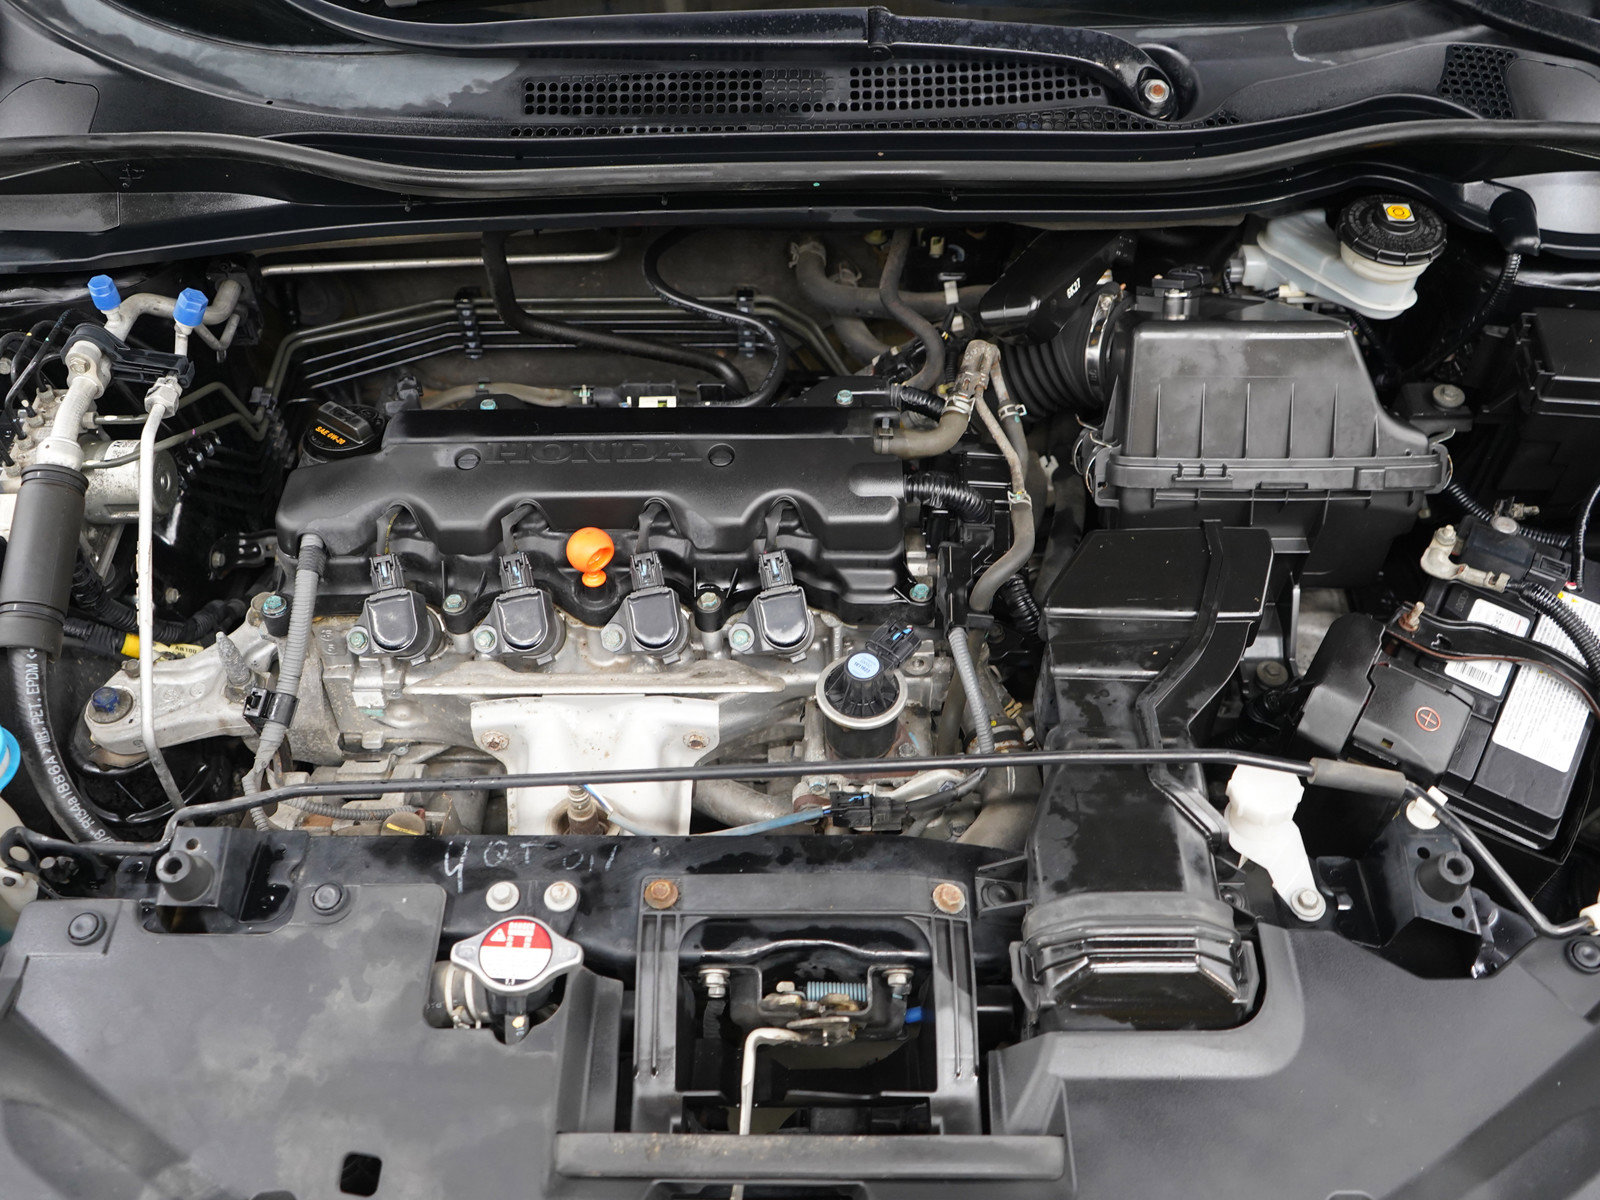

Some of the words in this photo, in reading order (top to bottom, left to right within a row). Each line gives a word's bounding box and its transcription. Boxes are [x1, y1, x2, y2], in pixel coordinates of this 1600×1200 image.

[315, 426, 330, 436] SAE
[327, 433, 346, 445] 0W-20
[484, 442, 703, 464] HONDA
[25, 663, 40, 695] EPDM
[444, 840, 471, 894] 4
